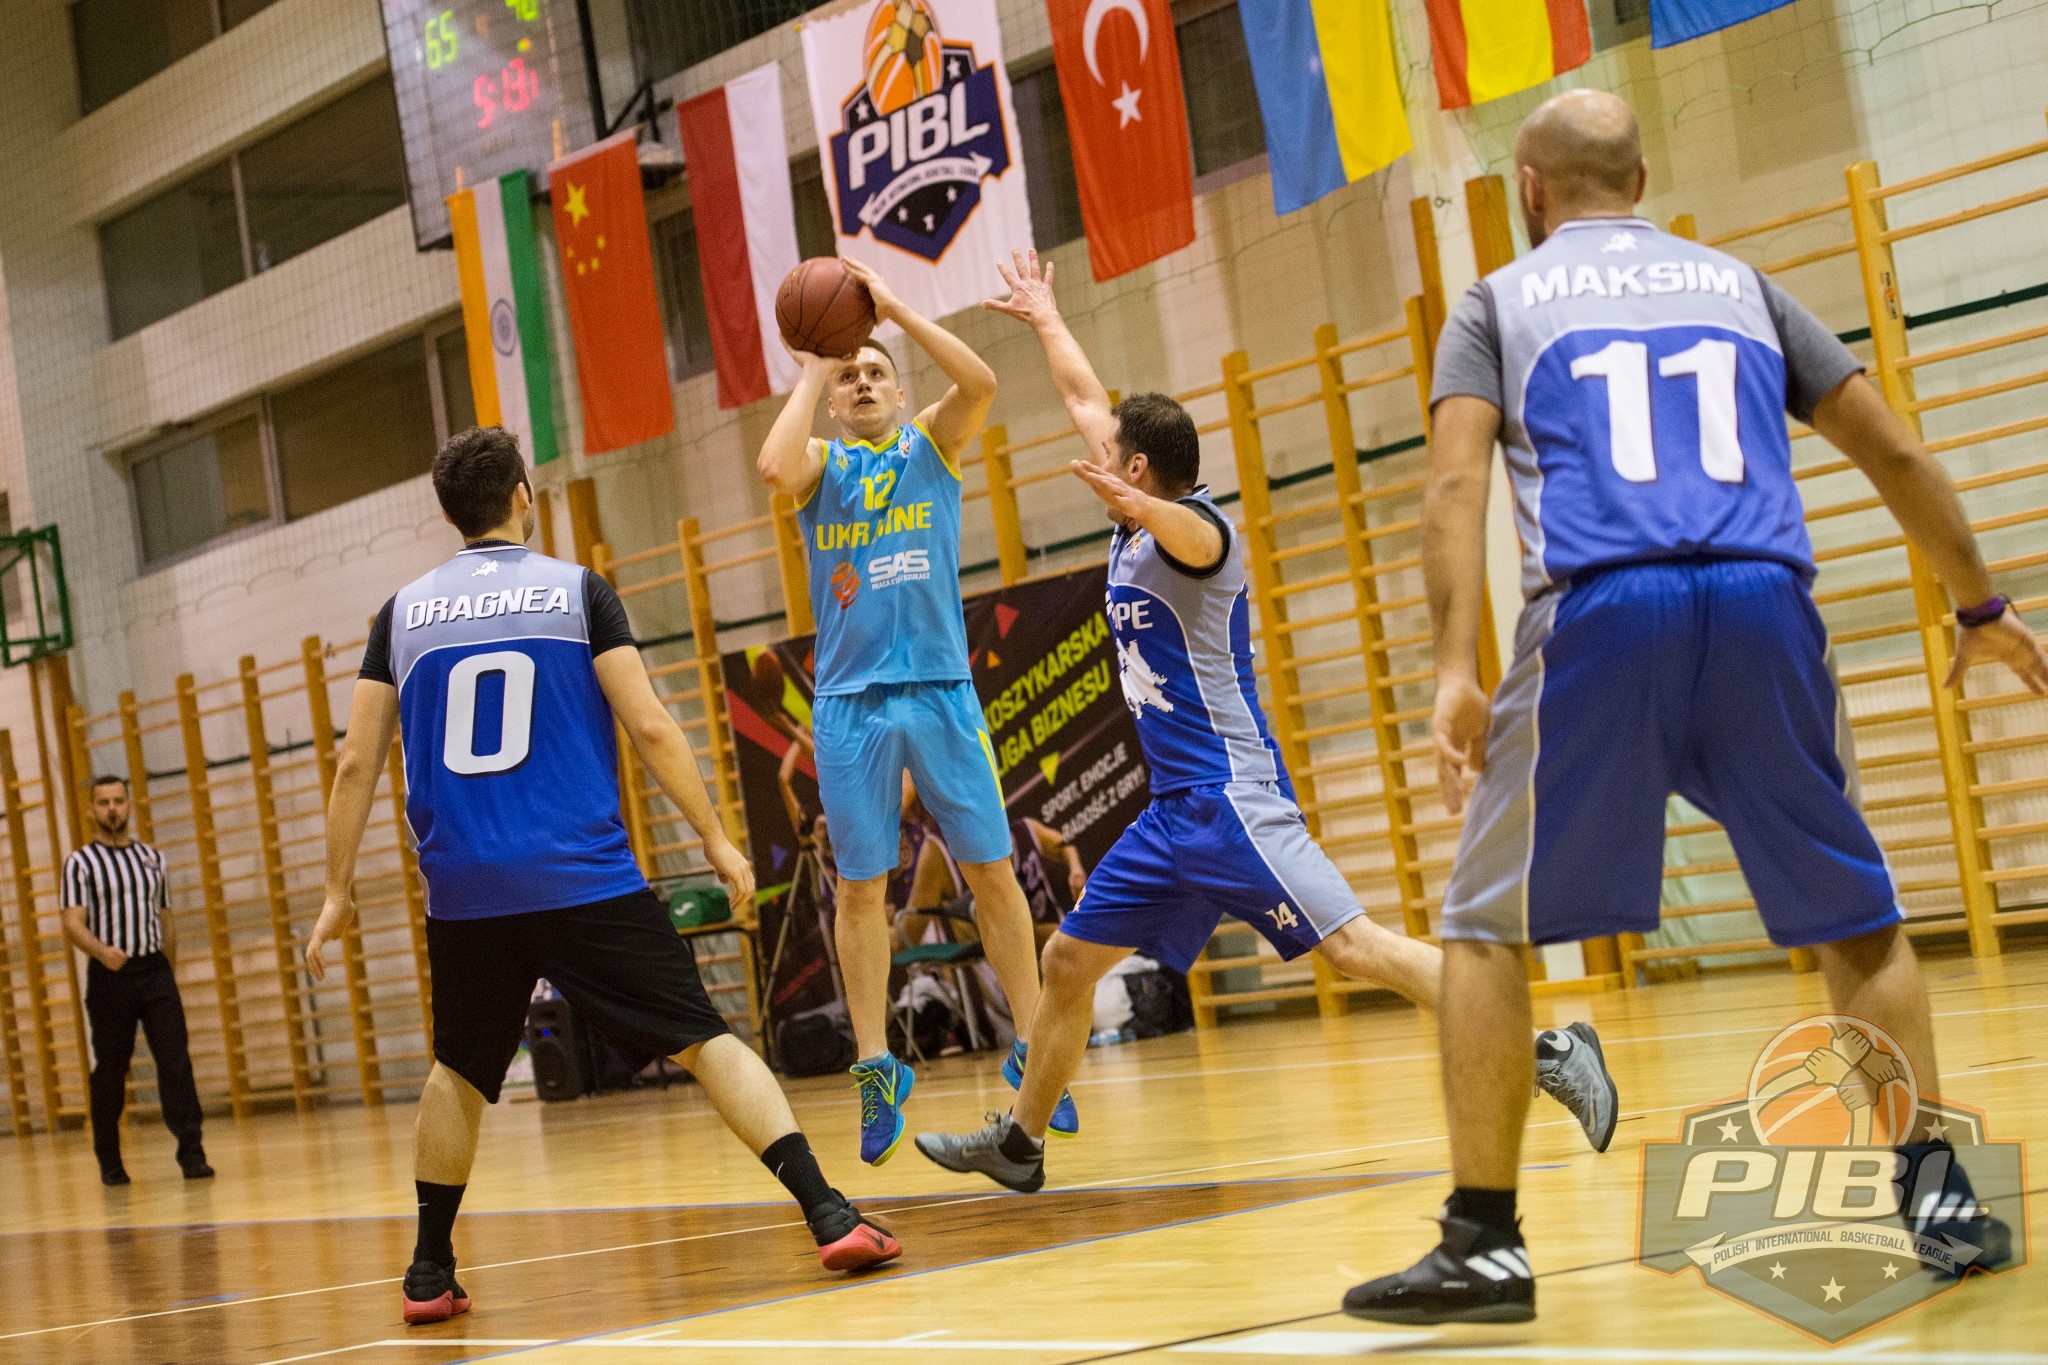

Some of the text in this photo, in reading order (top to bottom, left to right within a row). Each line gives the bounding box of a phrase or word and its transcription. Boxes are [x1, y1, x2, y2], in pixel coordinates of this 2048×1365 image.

[424, 10, 459, 71] 65
[848, 82, 990, 191] PIBL
[1521, 261, 1743, 308] MAKSIM
[1570, 338, 1745, 483] 11
[860, 469, 896, 511] 12
[868, 549, 930, 583] SAS
[406, 586, 570, 631] DRAGNEA
[443, 650, 536, 776] 0
[998, 658, 1111, 778] IGA BIZNESU
[1264, 901, 1299, 931] 14
